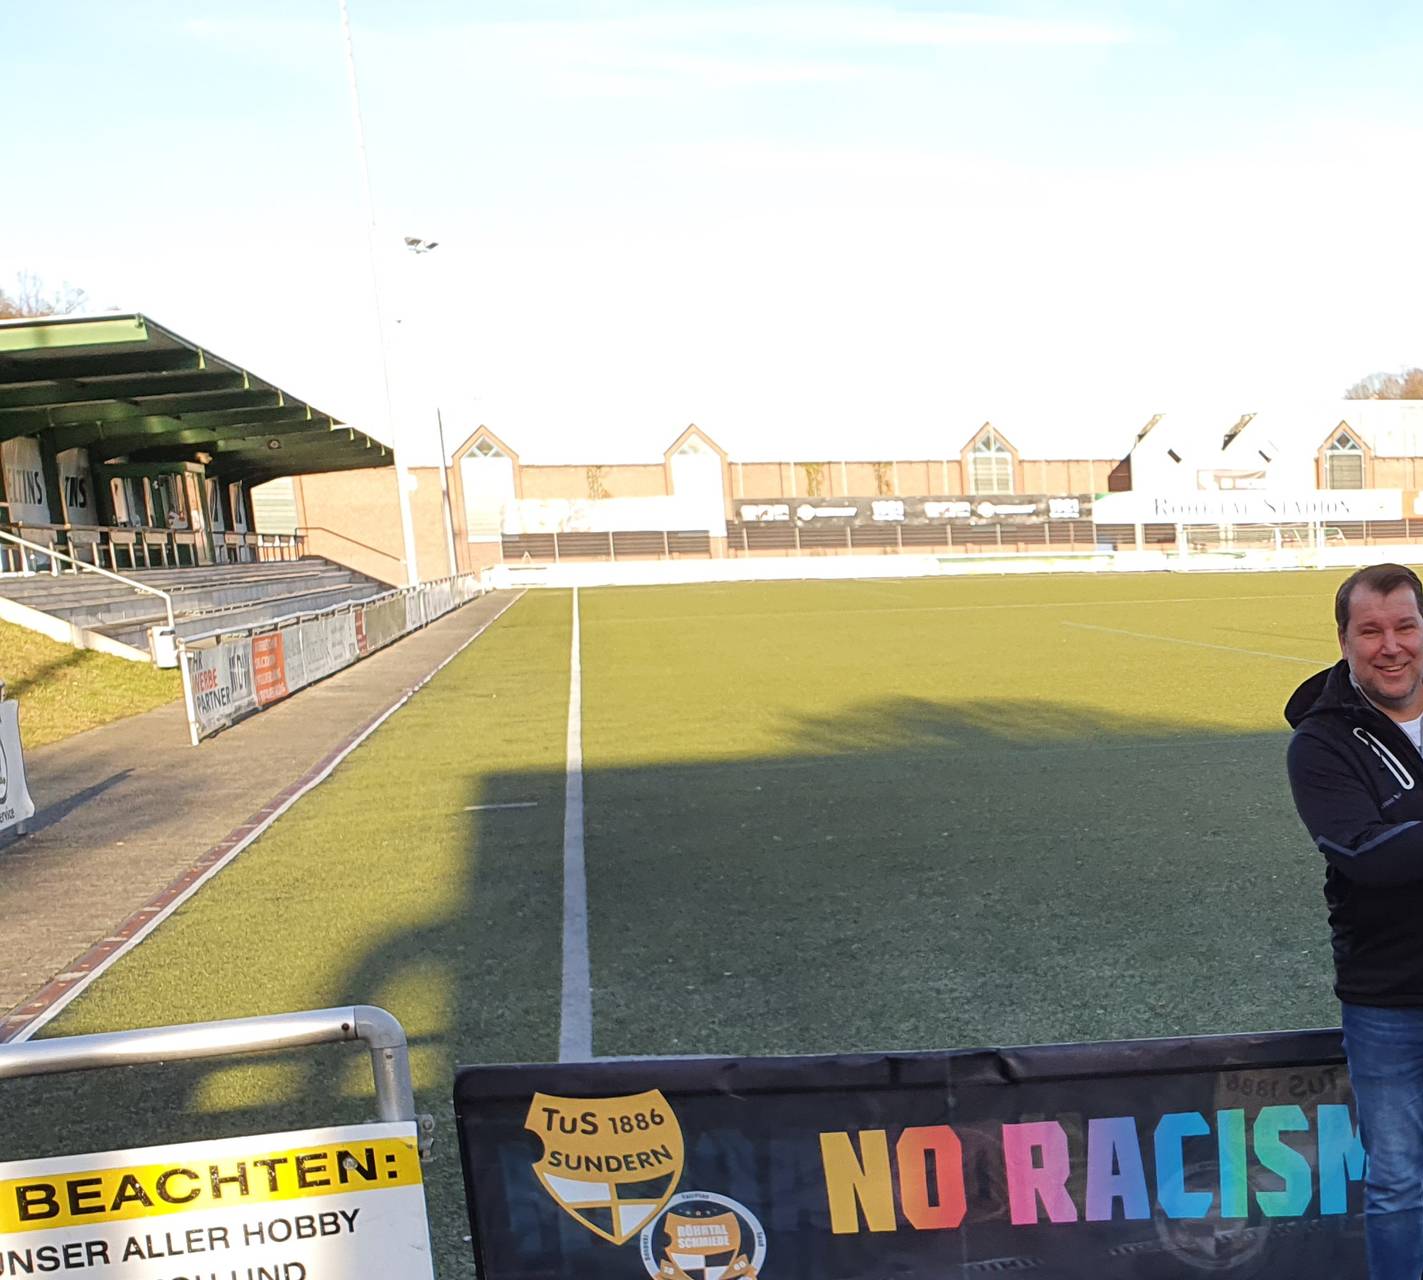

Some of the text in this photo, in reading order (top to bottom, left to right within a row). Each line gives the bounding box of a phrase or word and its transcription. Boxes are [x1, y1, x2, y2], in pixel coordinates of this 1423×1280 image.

[196, 686, 232, 714] PARTNER
[541, 1107, 665, 1135] TuS 1886
[548, 1144, 673, 1173] SUNDERN
[820, 1103, 1369, 1235] NO RACISM
[15, 1148, 398, 1221] BEACHTEN:
[0, 1208, 360, 1277] NSER ALLER HOBBY
[678, 1236, 730, 1249] SCHMIEDE
